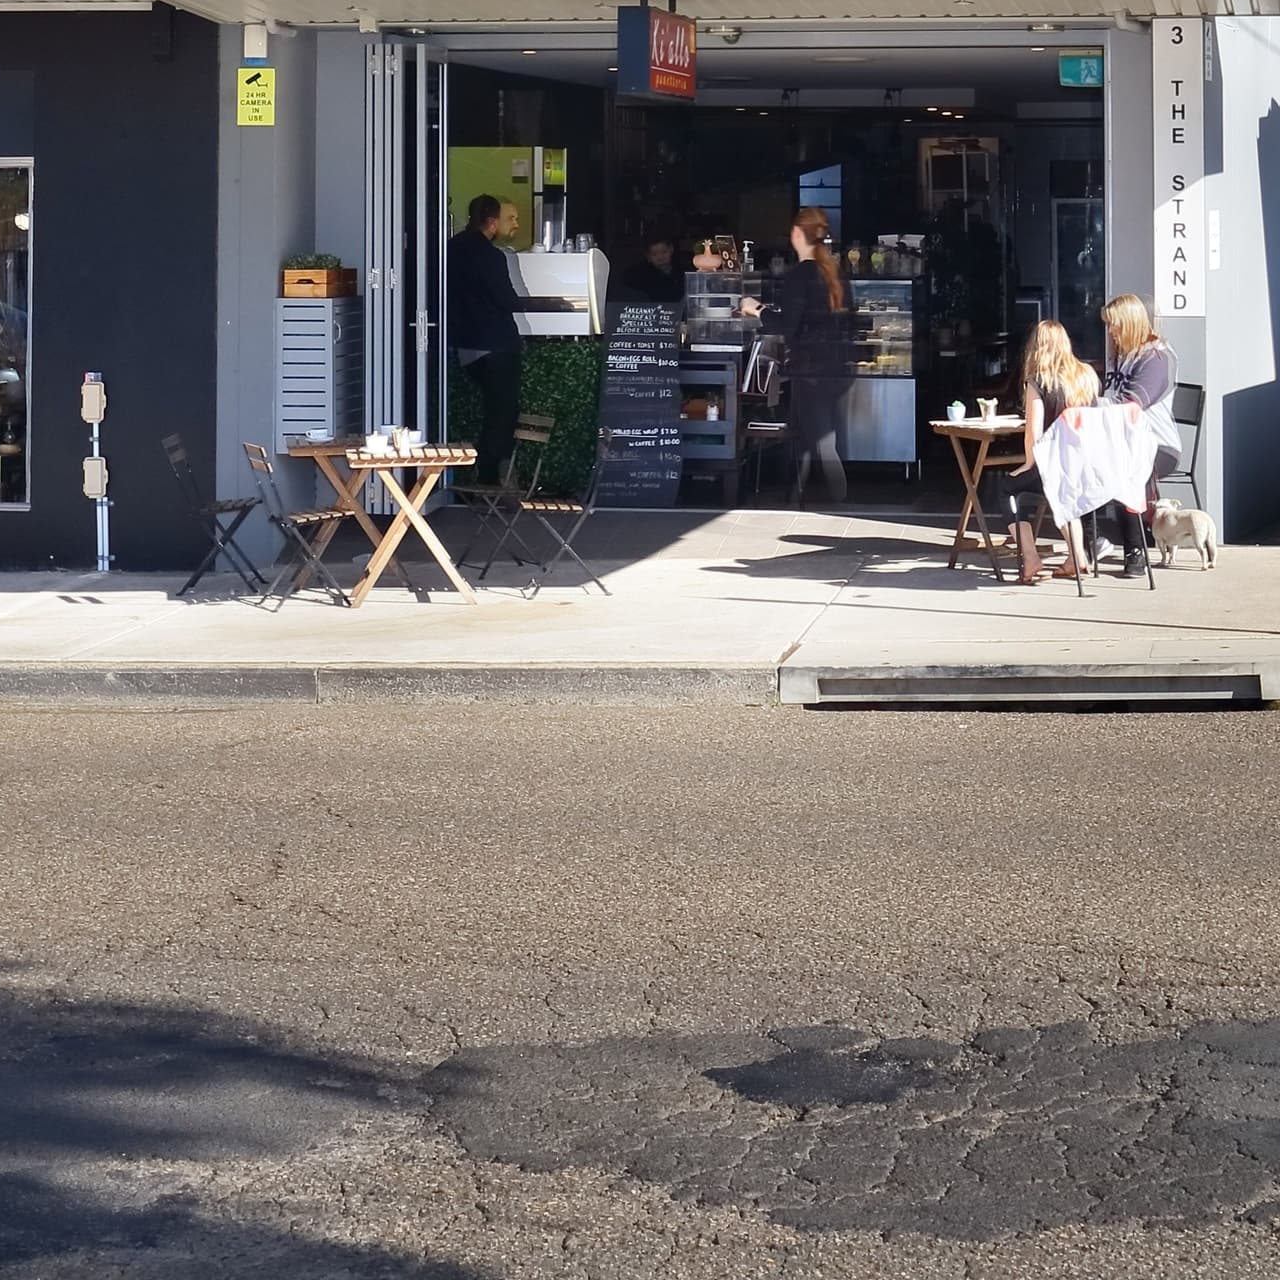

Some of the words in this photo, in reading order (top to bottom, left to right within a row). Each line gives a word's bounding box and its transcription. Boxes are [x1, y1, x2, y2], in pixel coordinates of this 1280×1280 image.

[1171, 26, 1184, 45] 3
[1171, 80, 1186, 144] THE
[1172, 175, 1187, 311] STRAND
